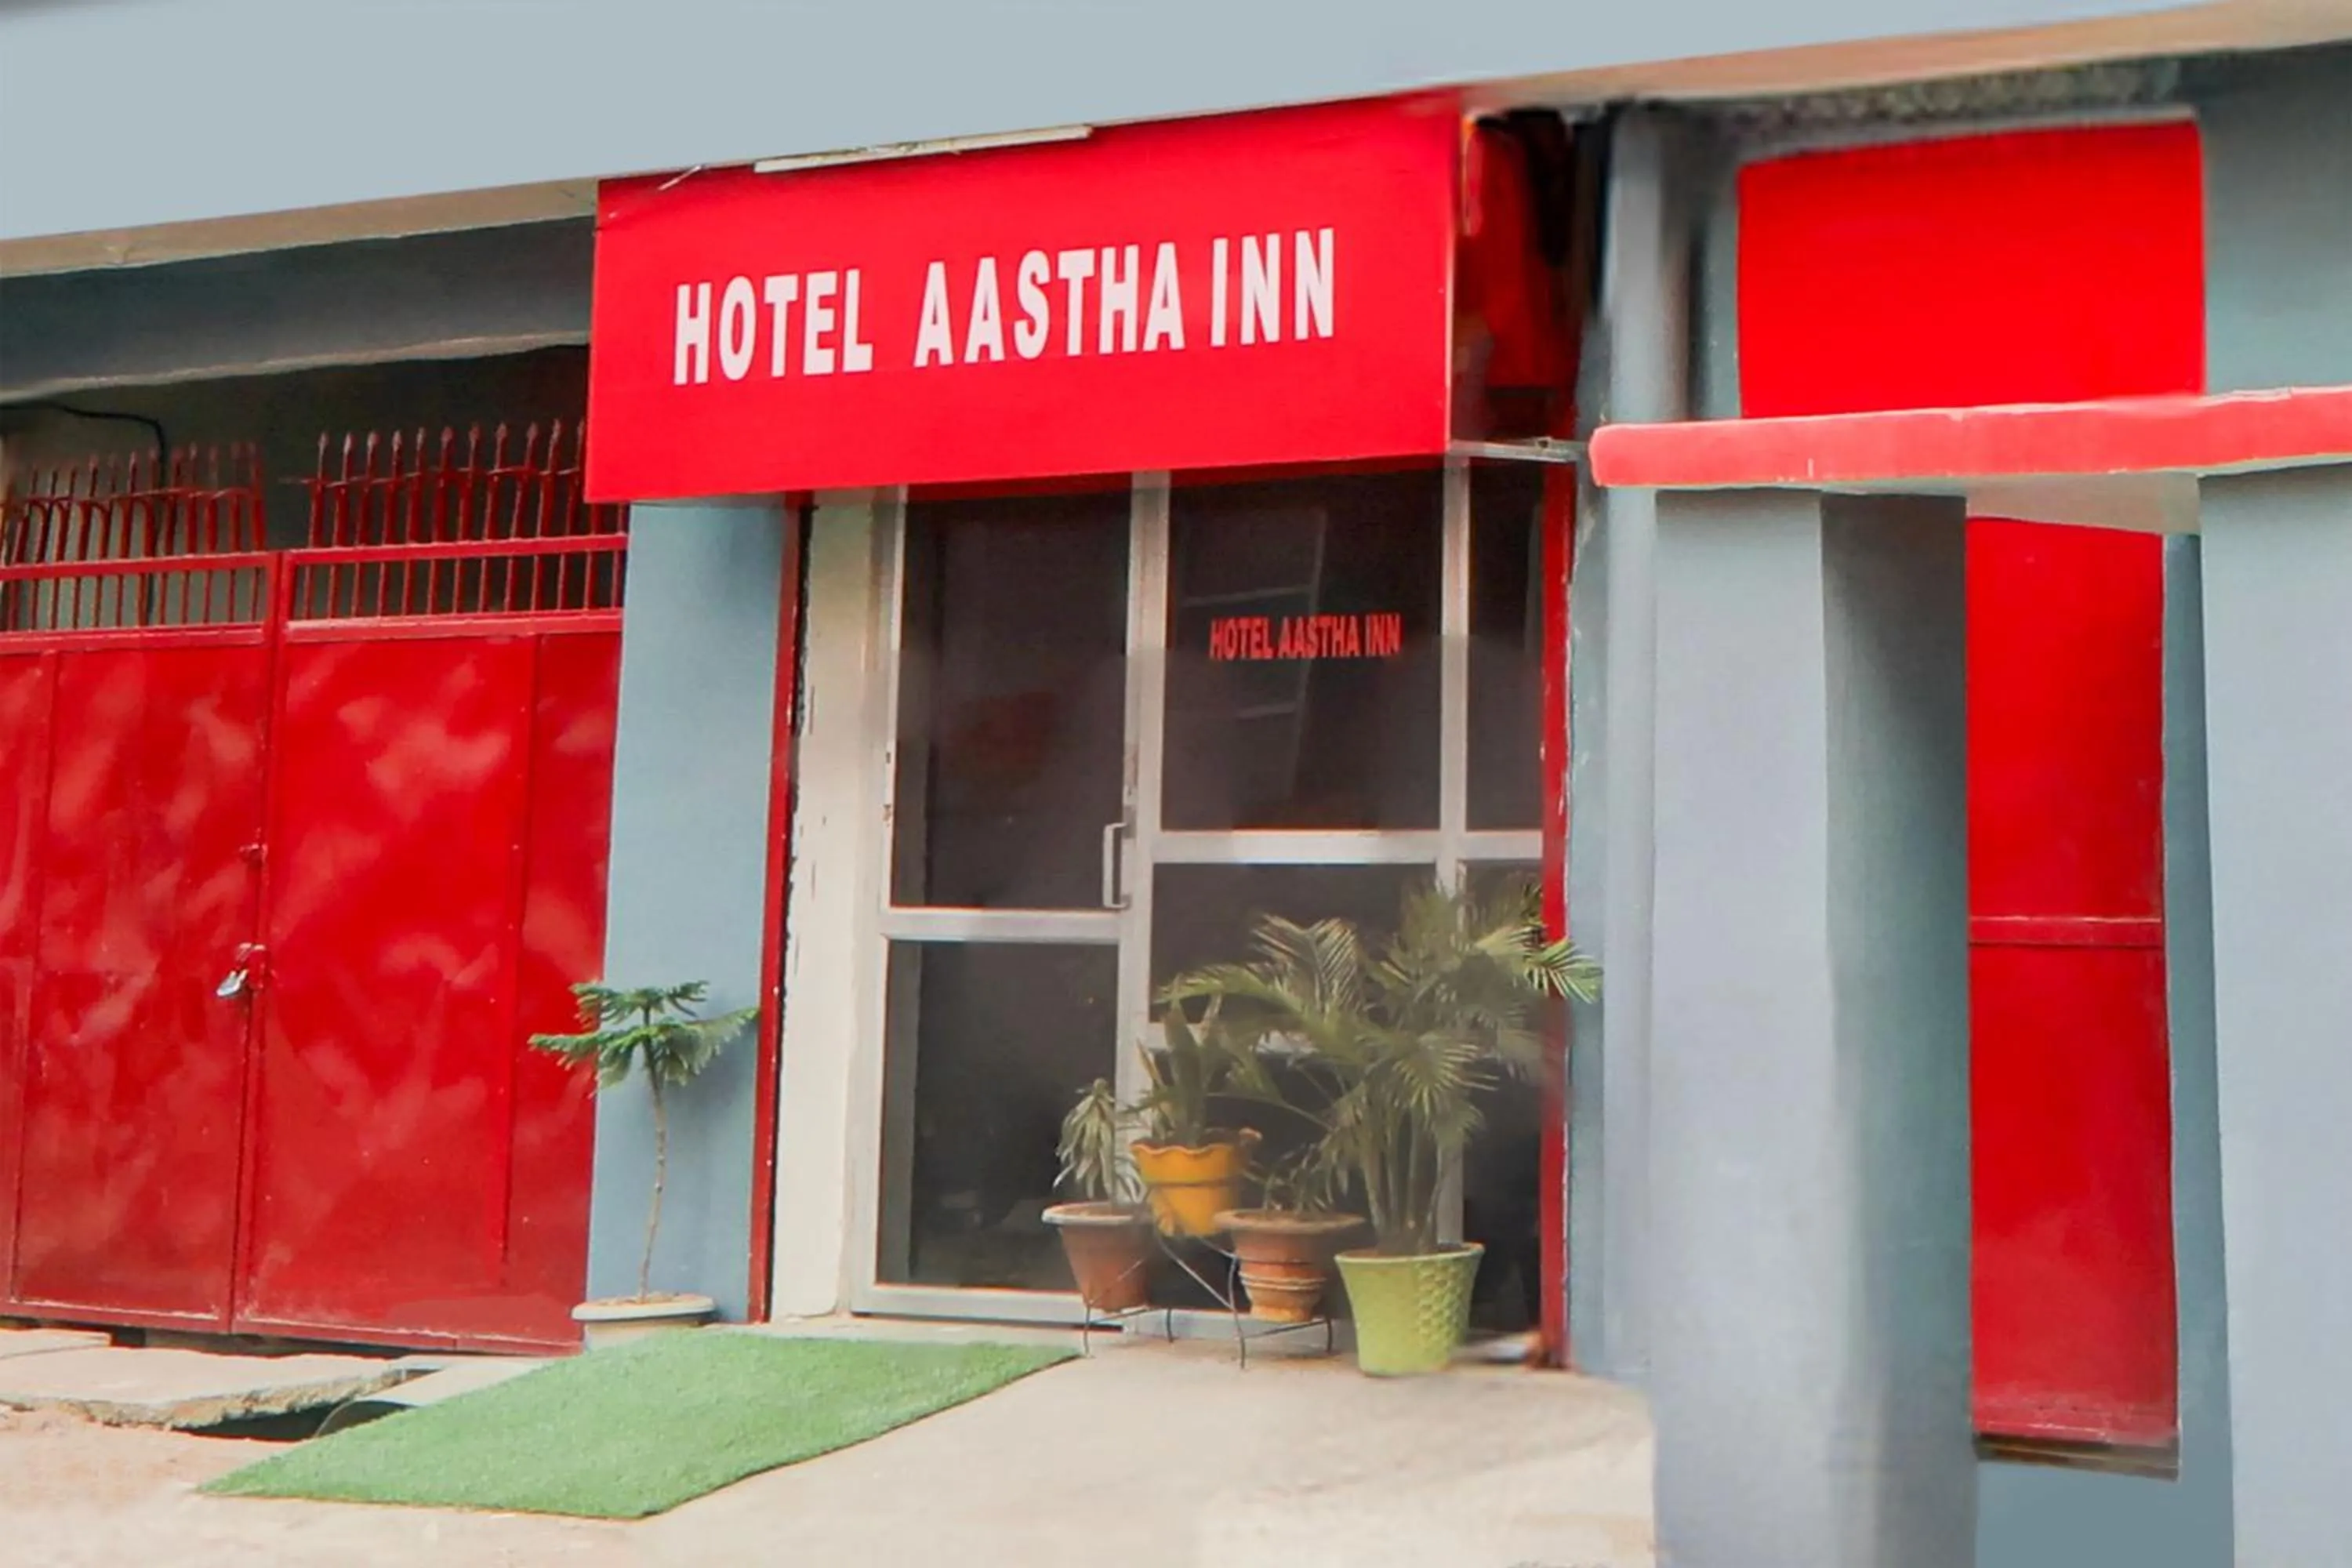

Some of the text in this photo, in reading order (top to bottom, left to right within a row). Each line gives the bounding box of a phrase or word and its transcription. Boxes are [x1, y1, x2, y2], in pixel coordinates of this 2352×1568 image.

[674, 228, 1334, 385] HOTEL AASTHA INN
[1210, 614, 1402, 660] HOTEL AASTHA INN
